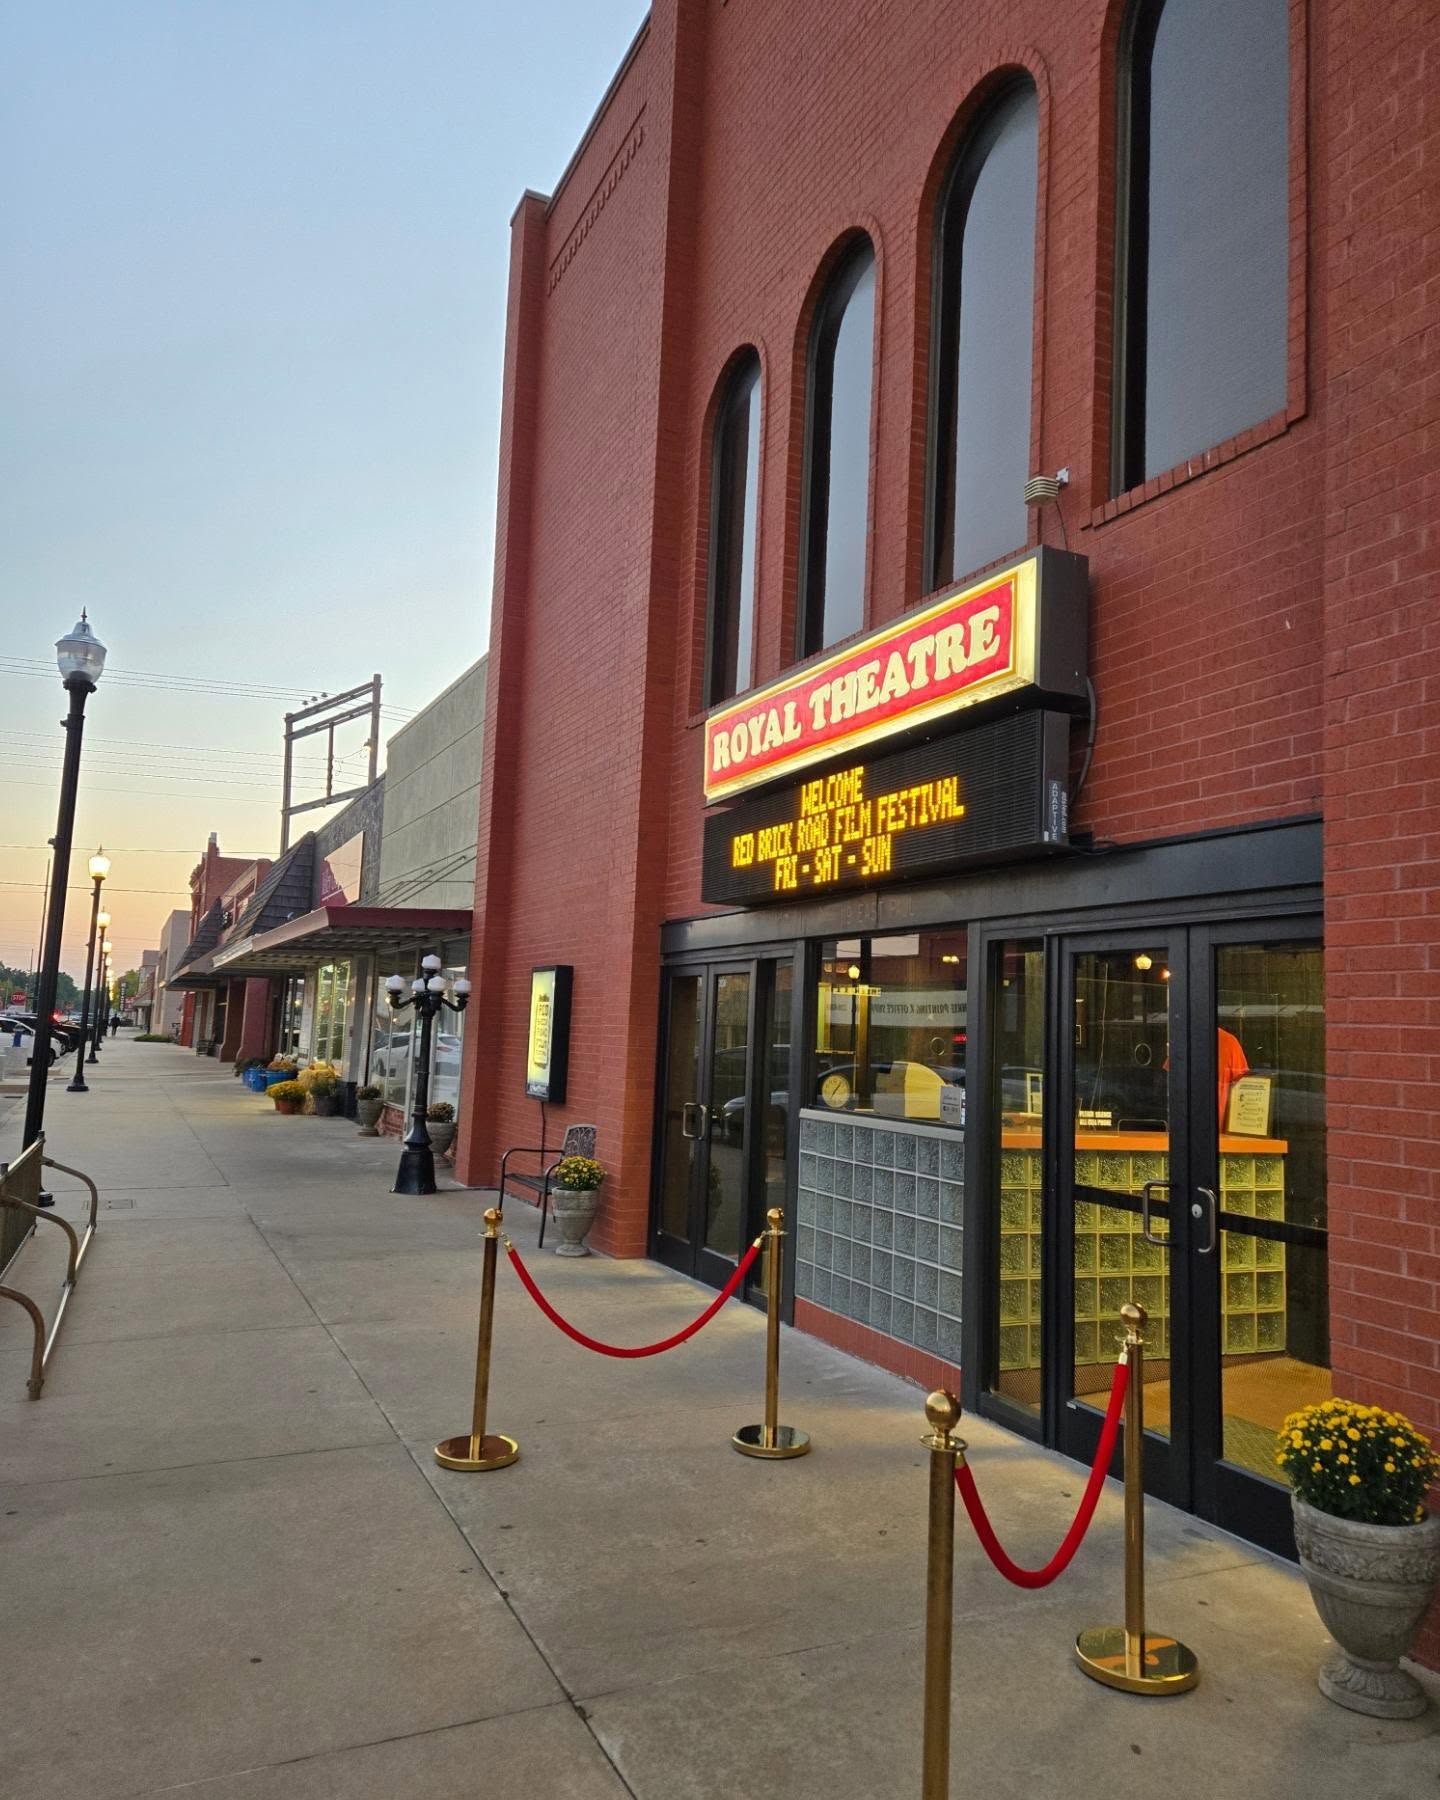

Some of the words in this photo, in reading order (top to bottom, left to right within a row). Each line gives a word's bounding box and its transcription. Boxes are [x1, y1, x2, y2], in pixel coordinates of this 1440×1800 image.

[713, 701, 802, 773] ROYAL
[808, 605, 1001, 731] THEATRE
[732, 832, 754, 867] RED
[758, 822, 793, 862] BRICK
[797, 812, 829, 852] ROAD
[834, 800, 872, 843] FILM
[877, 776, 965, 834] FESTIVAL
[801, 766, 864, 817] WELCOME
[774, 854, 798, 890] FRI
[814, 845, 842, 884] SAT
[861, 833, 891, 875] SUN
